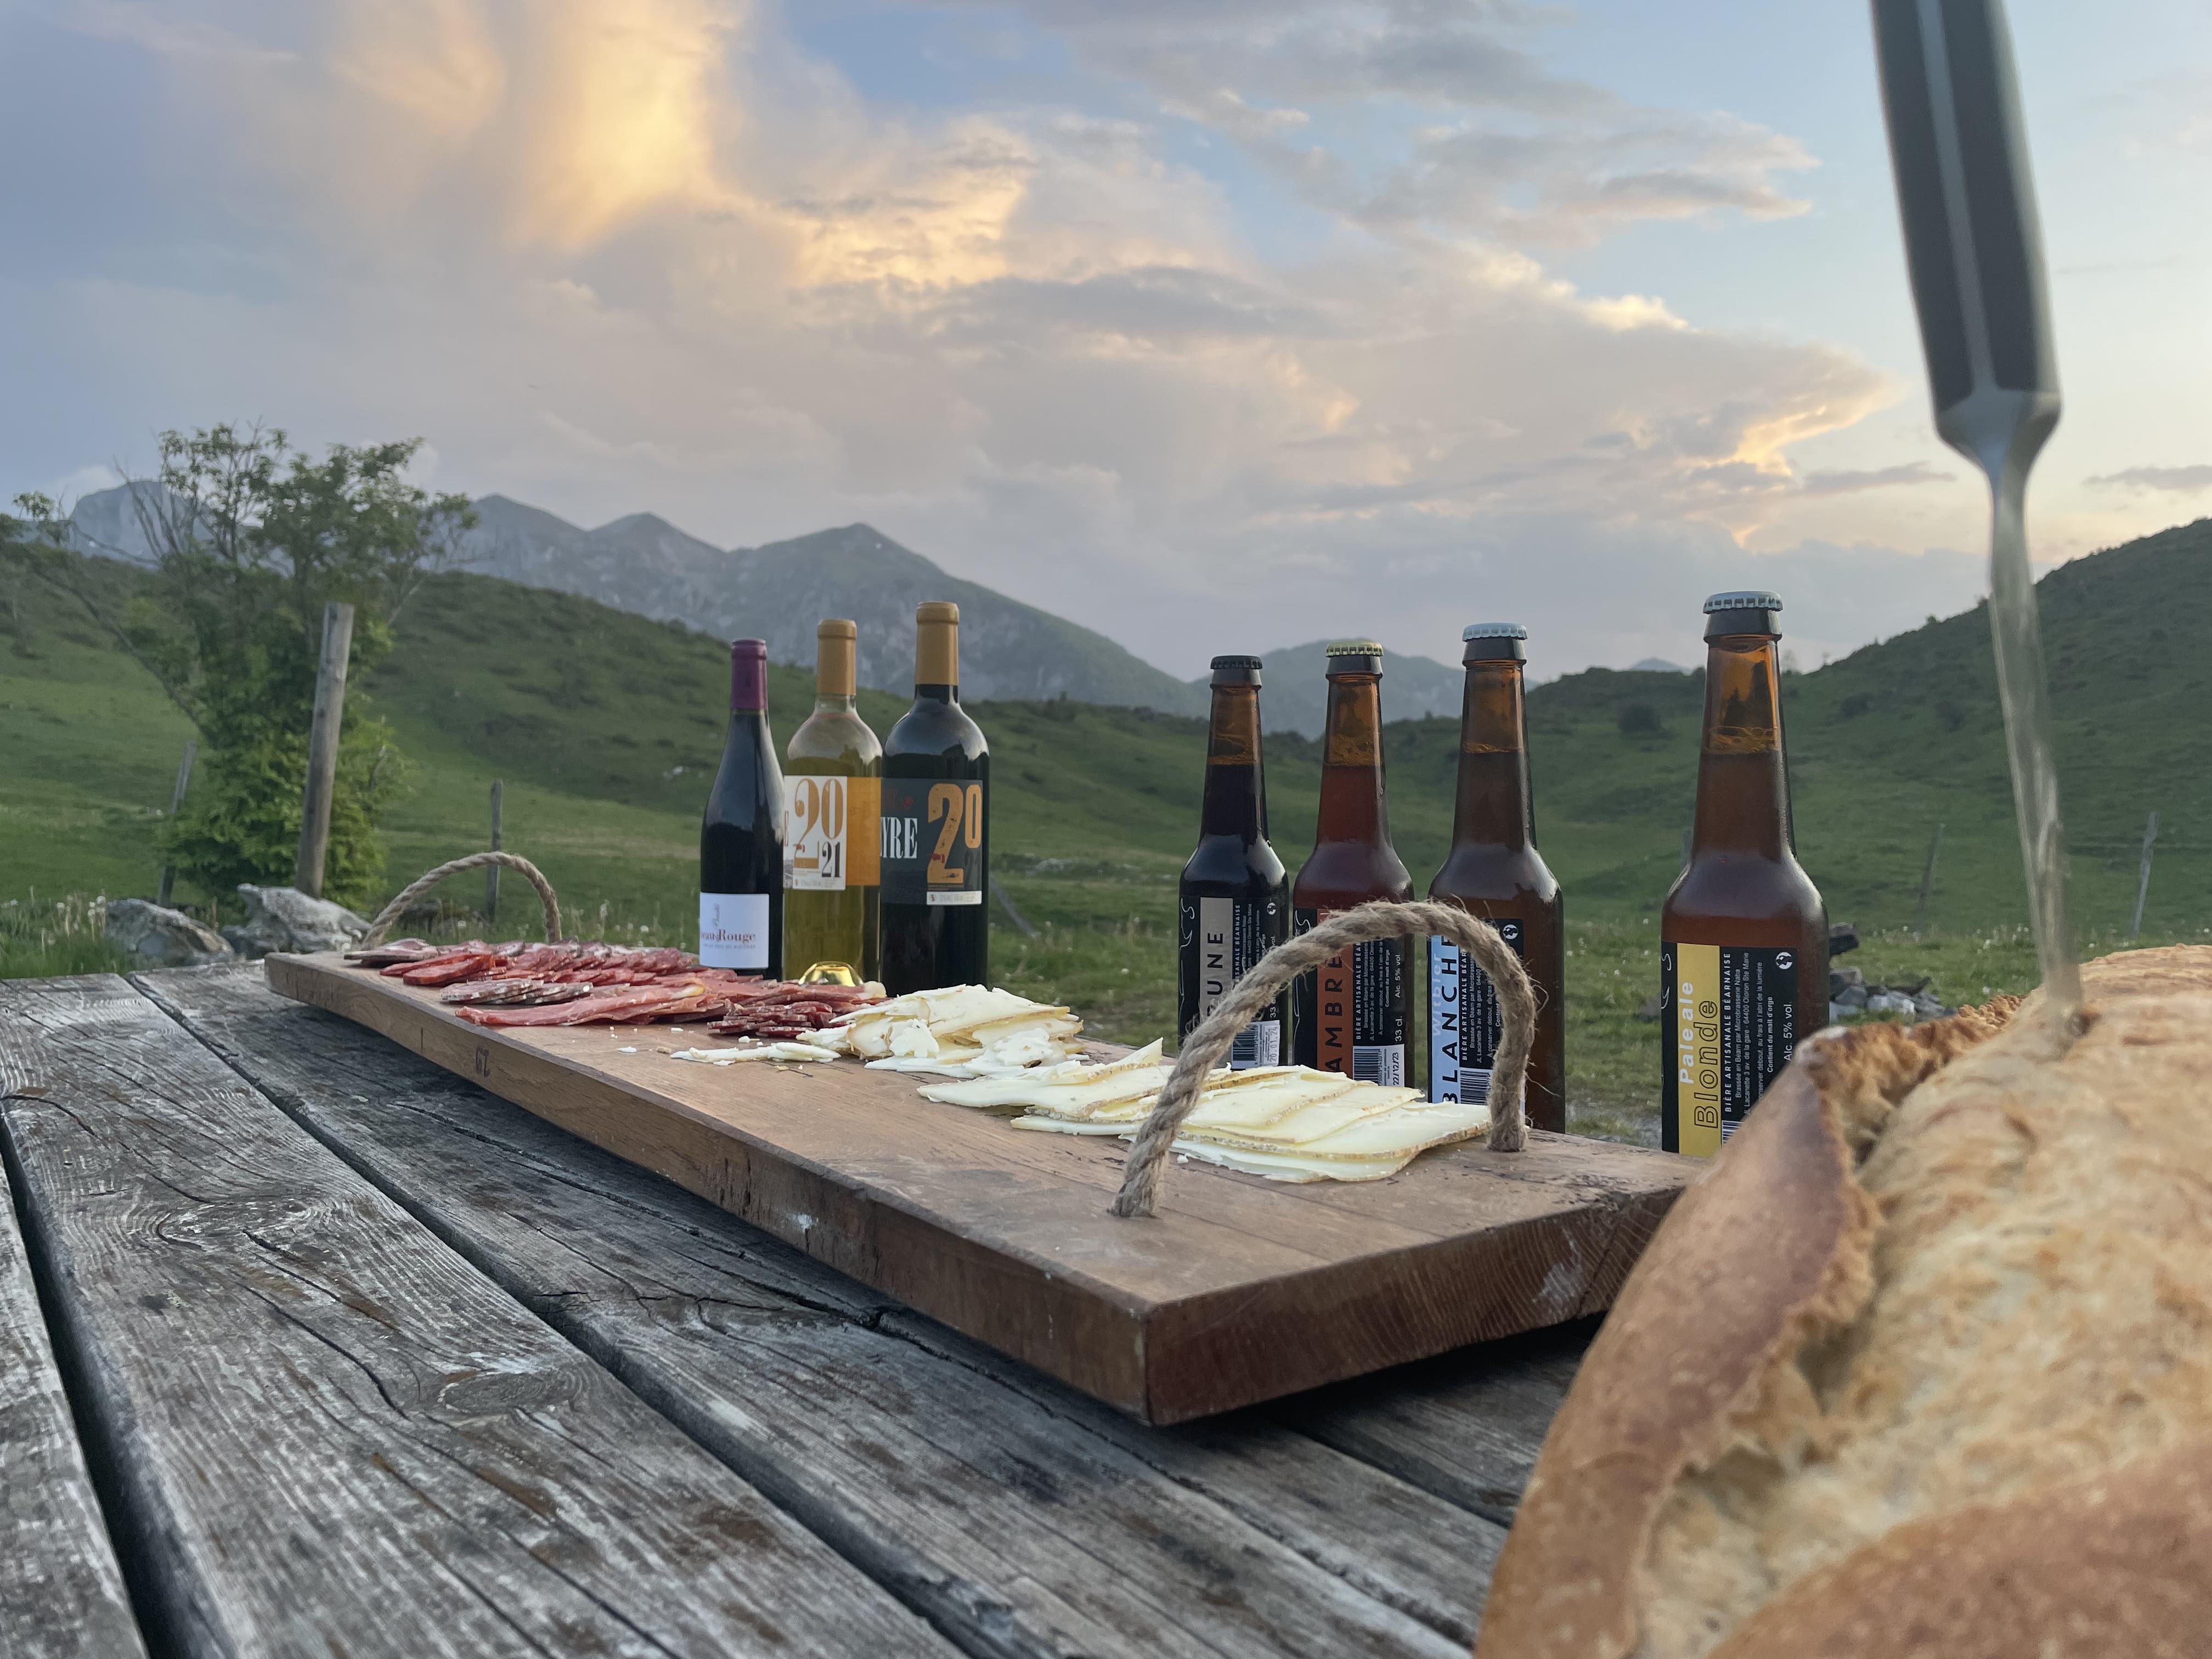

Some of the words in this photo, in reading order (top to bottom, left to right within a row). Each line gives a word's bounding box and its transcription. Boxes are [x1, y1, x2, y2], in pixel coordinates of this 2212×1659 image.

[794, 778, 844, 868] 20
[880, 816, 918, 859] YRE
[927, 783, 982, 883] 20
[822, 841, 842, 878] 21
[1206, 932, 1223, 1017] UNE
[1395, 968, 1401, 981] 5%
[1432, 953, 1442, 1036] Witbier
[1722, 953, 1731, 1010] BÉARNAISE
[1269, 1007, 1276, 1018] 33
[1324, 956, 1343, 1071] AMBRE
[1679, 982, 1694, 1021] ale
[1395, 1029, 1402, 1042] 33
[1724, 1015, 1732, 1079] ARTISANALE
[1758, 1039, 1763, 1047] au
[1767, 1035, 1773, 1043] du
[1783, 1022, 1792, 1039] 5%
[1679, 1029, 1695, 1085] Pale
[1693, 1001, 1718, 1128] Blonde
[1744, 1052, 1750, 1060] de
[1723, 1084, 1732, 1112] BIÈRE
